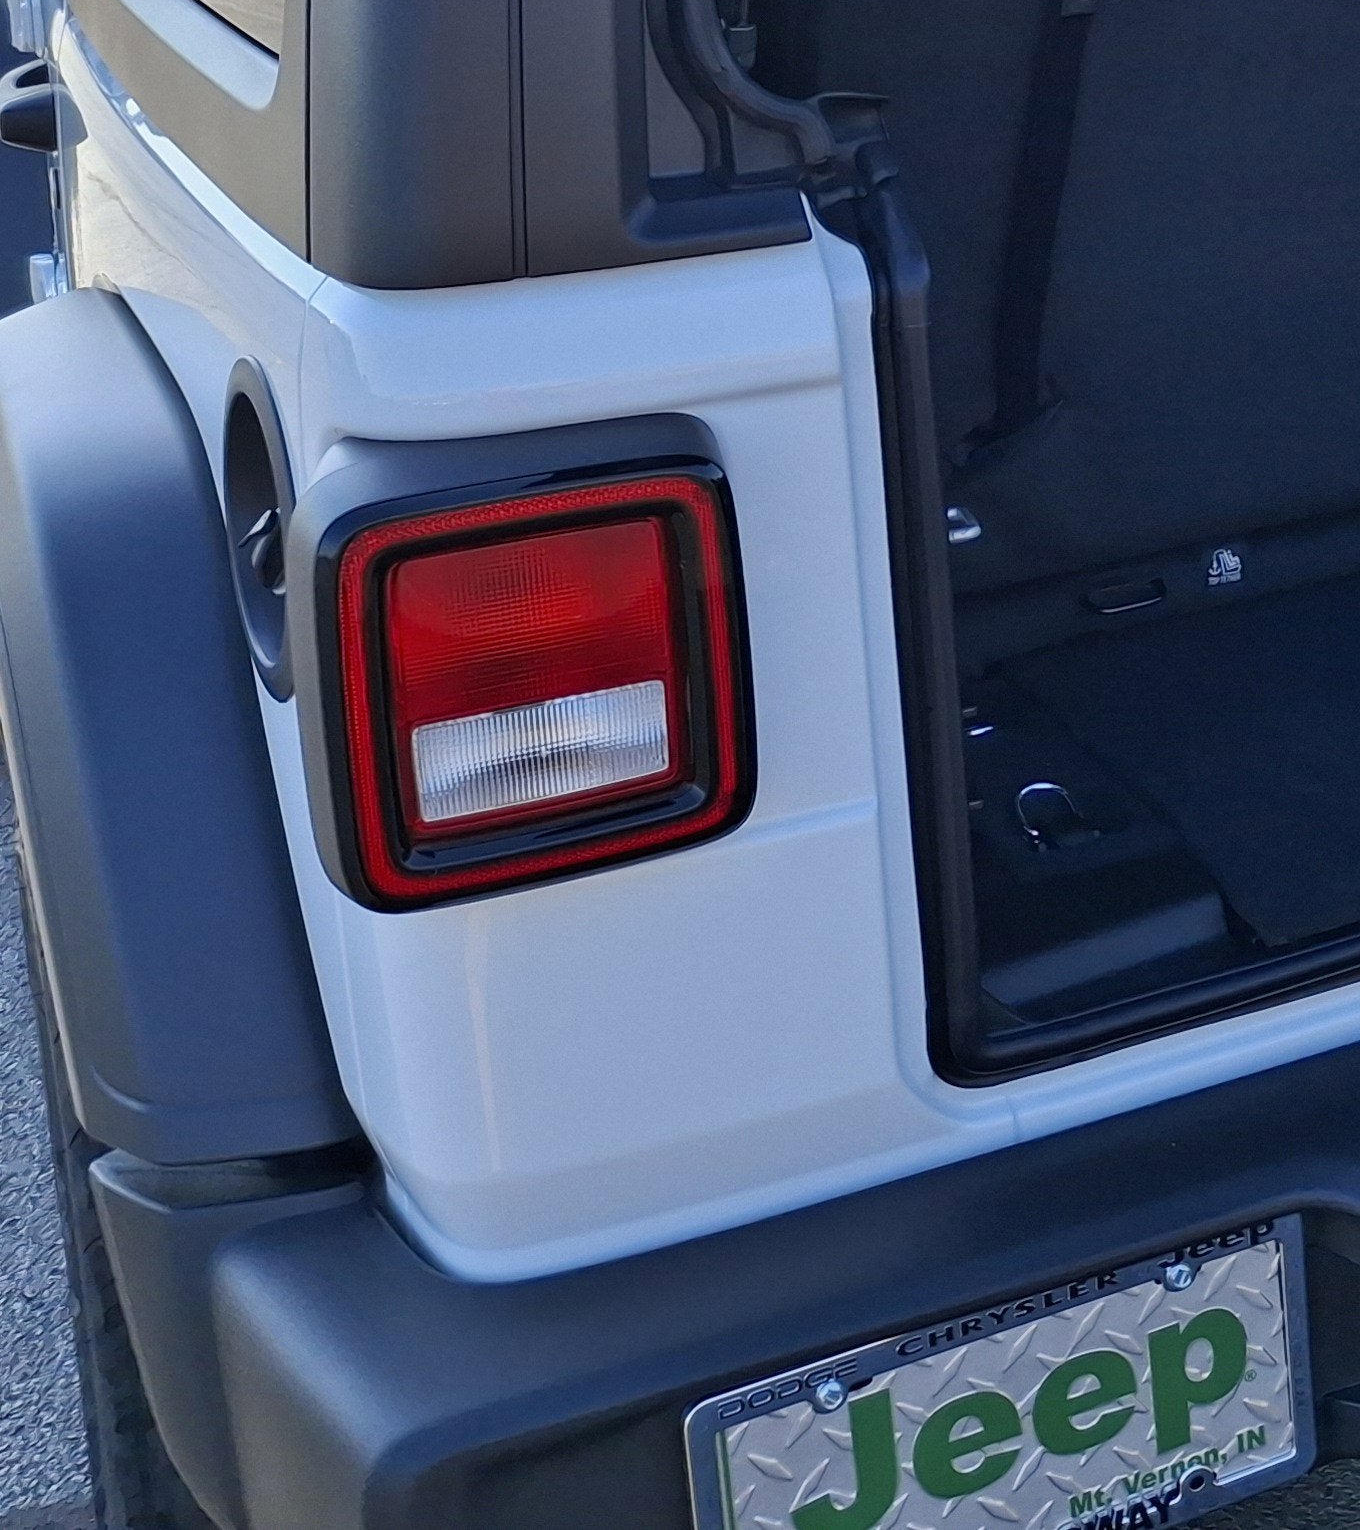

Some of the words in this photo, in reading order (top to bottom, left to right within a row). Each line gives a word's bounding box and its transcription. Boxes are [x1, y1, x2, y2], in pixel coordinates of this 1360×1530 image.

[717, 1357, 858, 1420] DODGE
[896, 1269, 1118, 1357] CHRYSLER
[1157, 1218, 1274, 1270] Jeep
[792, 1306, 1248, 1530] Jeep
[1067, 1486, 1113, 1519] Mt.
[1122, 1446, 1228, 1496] Vernon,
[1236, 1424, 1266, 1454] IN
[1063, 1488, 1181, 1530] WAY
